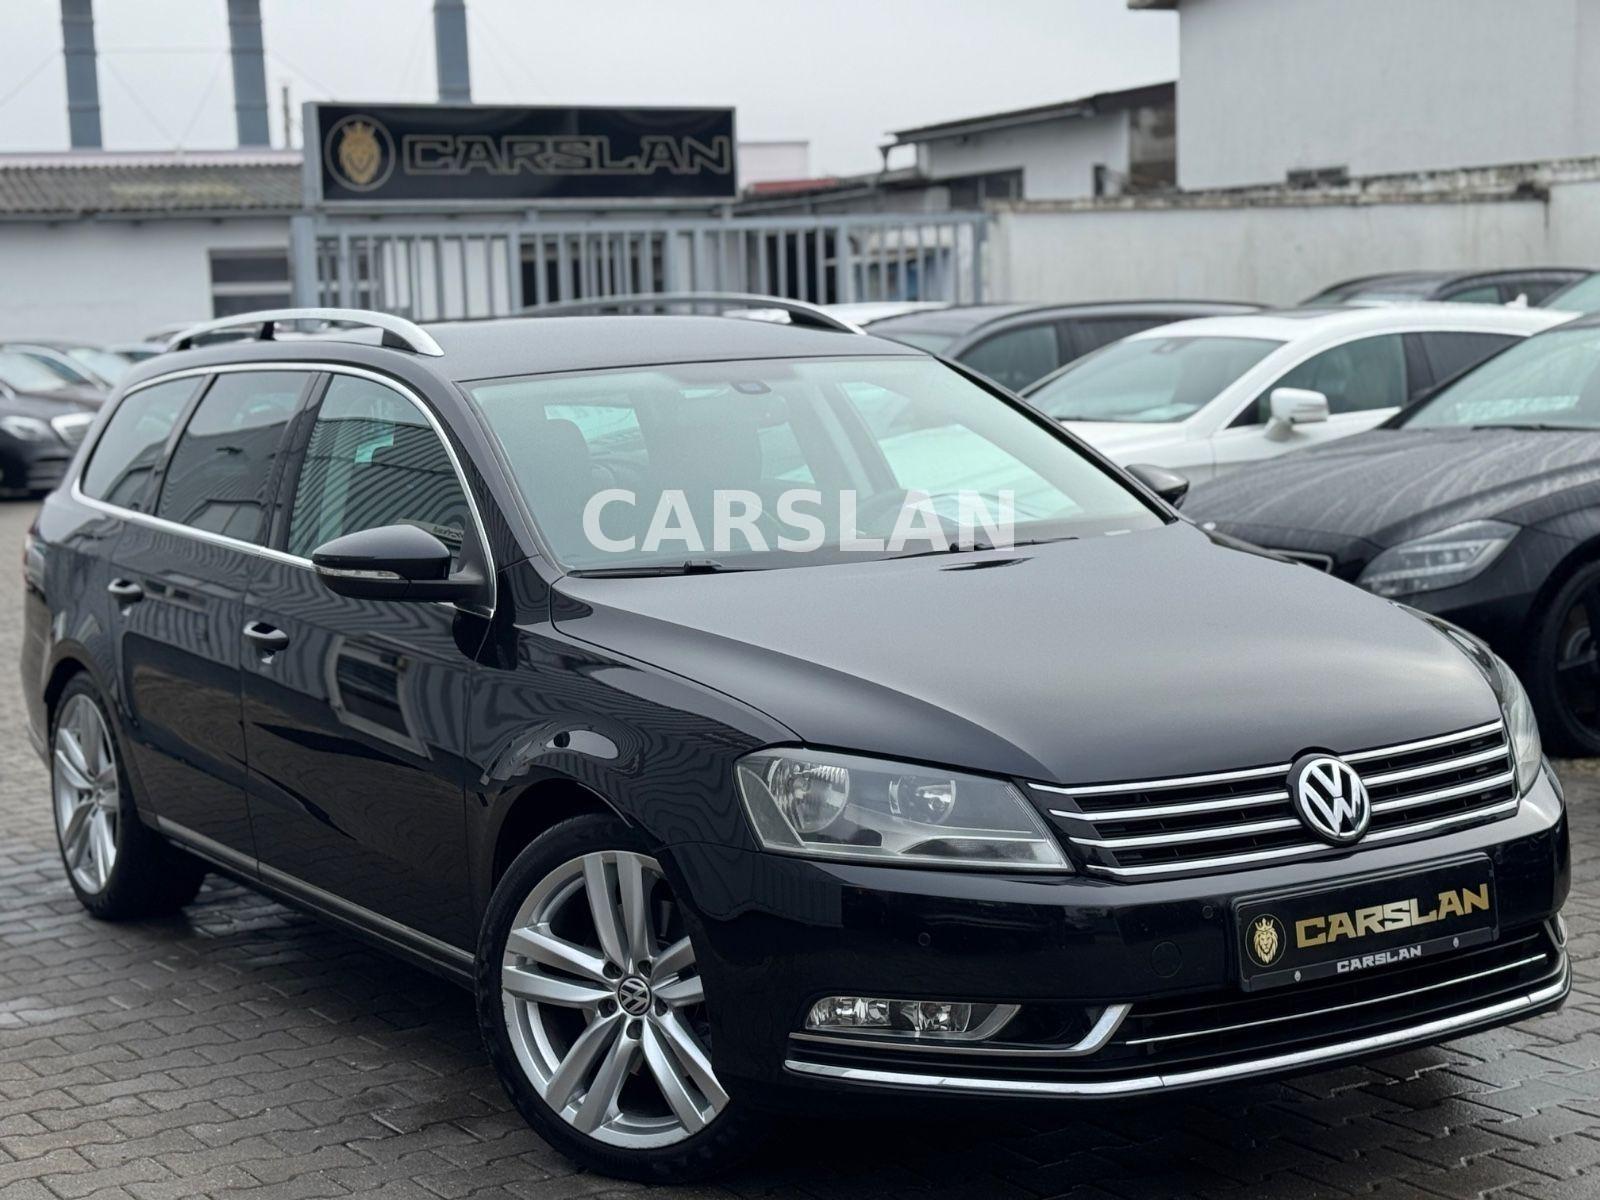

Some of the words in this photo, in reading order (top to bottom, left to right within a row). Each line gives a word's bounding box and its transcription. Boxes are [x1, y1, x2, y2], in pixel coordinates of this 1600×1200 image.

[403, 135, 731, 175] CARSLAN
[1299, 758, 1370, 838] VW
[1295, 883, 1489, 948] CARSLAN
[1337, 945, 1422, 973] CARSLAN
